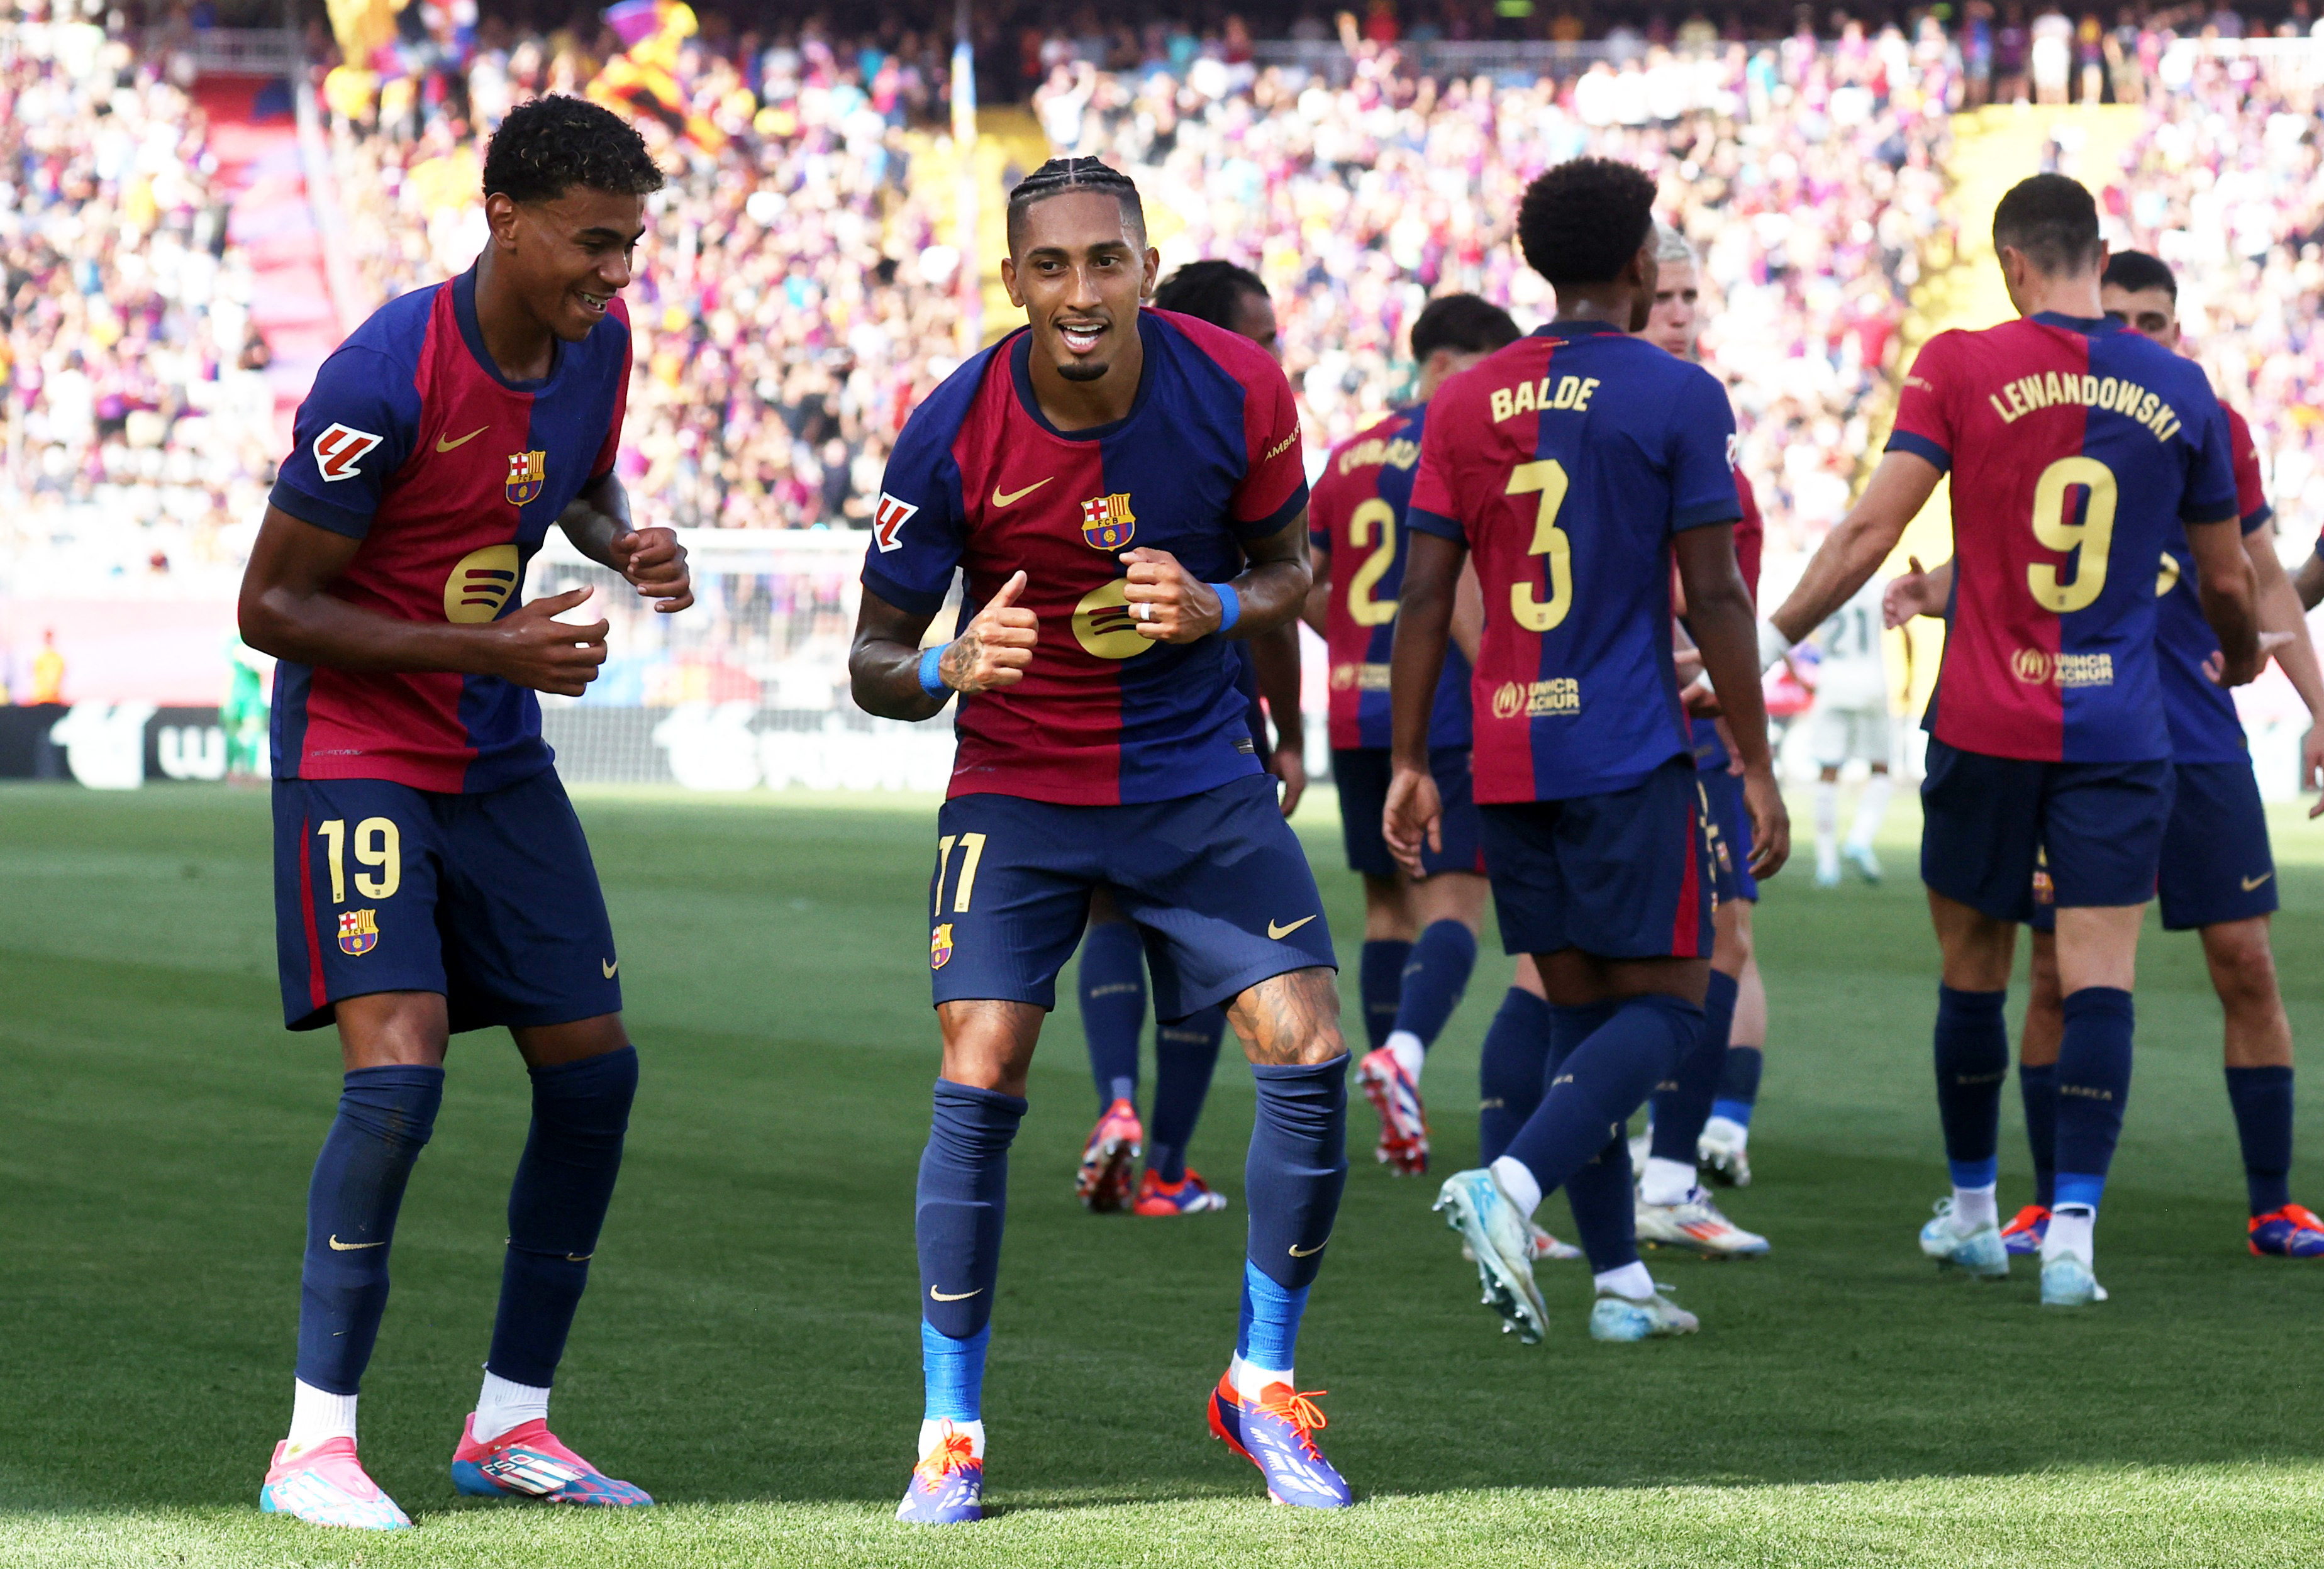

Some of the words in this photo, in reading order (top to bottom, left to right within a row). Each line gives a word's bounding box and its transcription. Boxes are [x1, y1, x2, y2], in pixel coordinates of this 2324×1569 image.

[1491, 375, 1601, 423] BALDE
[1989, 371, 2181, 442] LEWANDOWSKI
[1347, 499, 1399, 626] 2
[1505, 458, 1572, 631] 3
[2027, 457, 2118, 613] 9
[317, 817, 401, 904] 19
[935, 832, 986, 917] 11
[482, 1453, 535, 1476] F50
